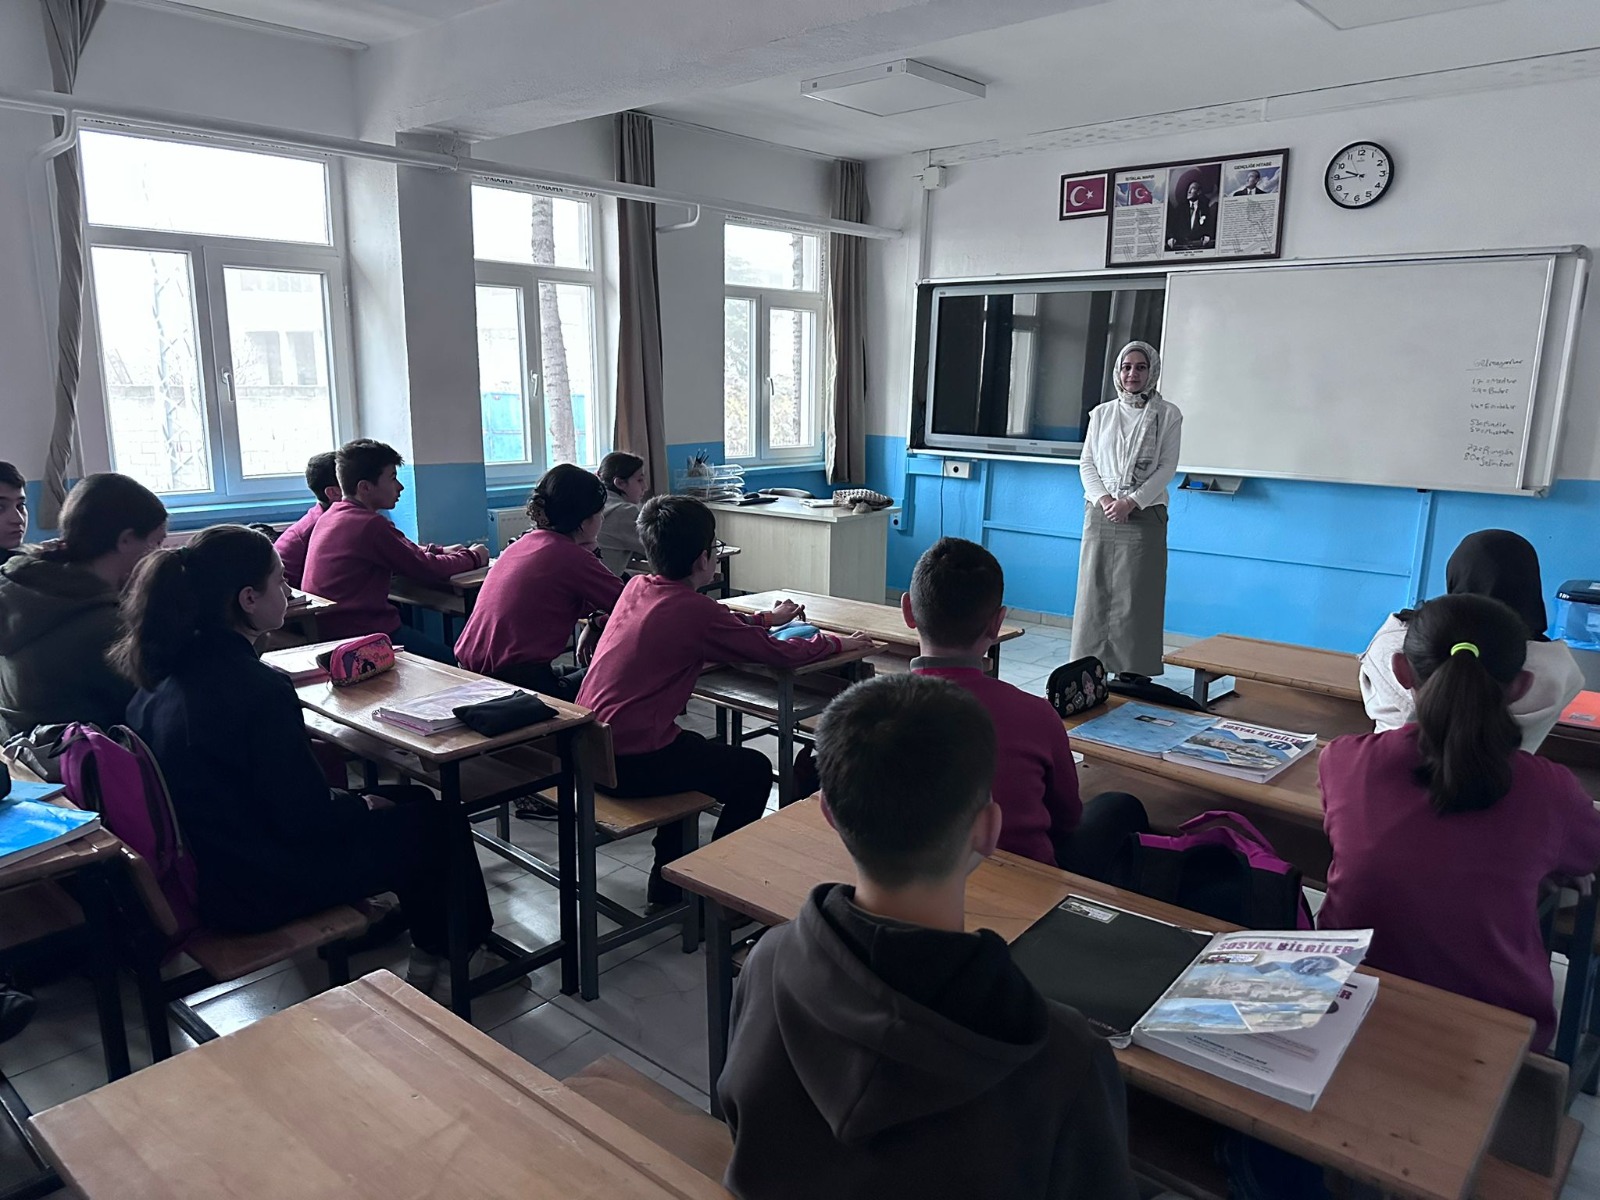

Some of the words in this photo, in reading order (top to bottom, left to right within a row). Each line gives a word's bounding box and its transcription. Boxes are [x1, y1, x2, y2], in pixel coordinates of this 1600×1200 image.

[1338, 162, 1345, 170] 10
[1376, 159, 1383, 167] 2
[1353, 194, 1360, 202] 6
[1217, 941, 1273, 951] SOSYAL
[1276, 940, 1355, 955] BİLGİLER
